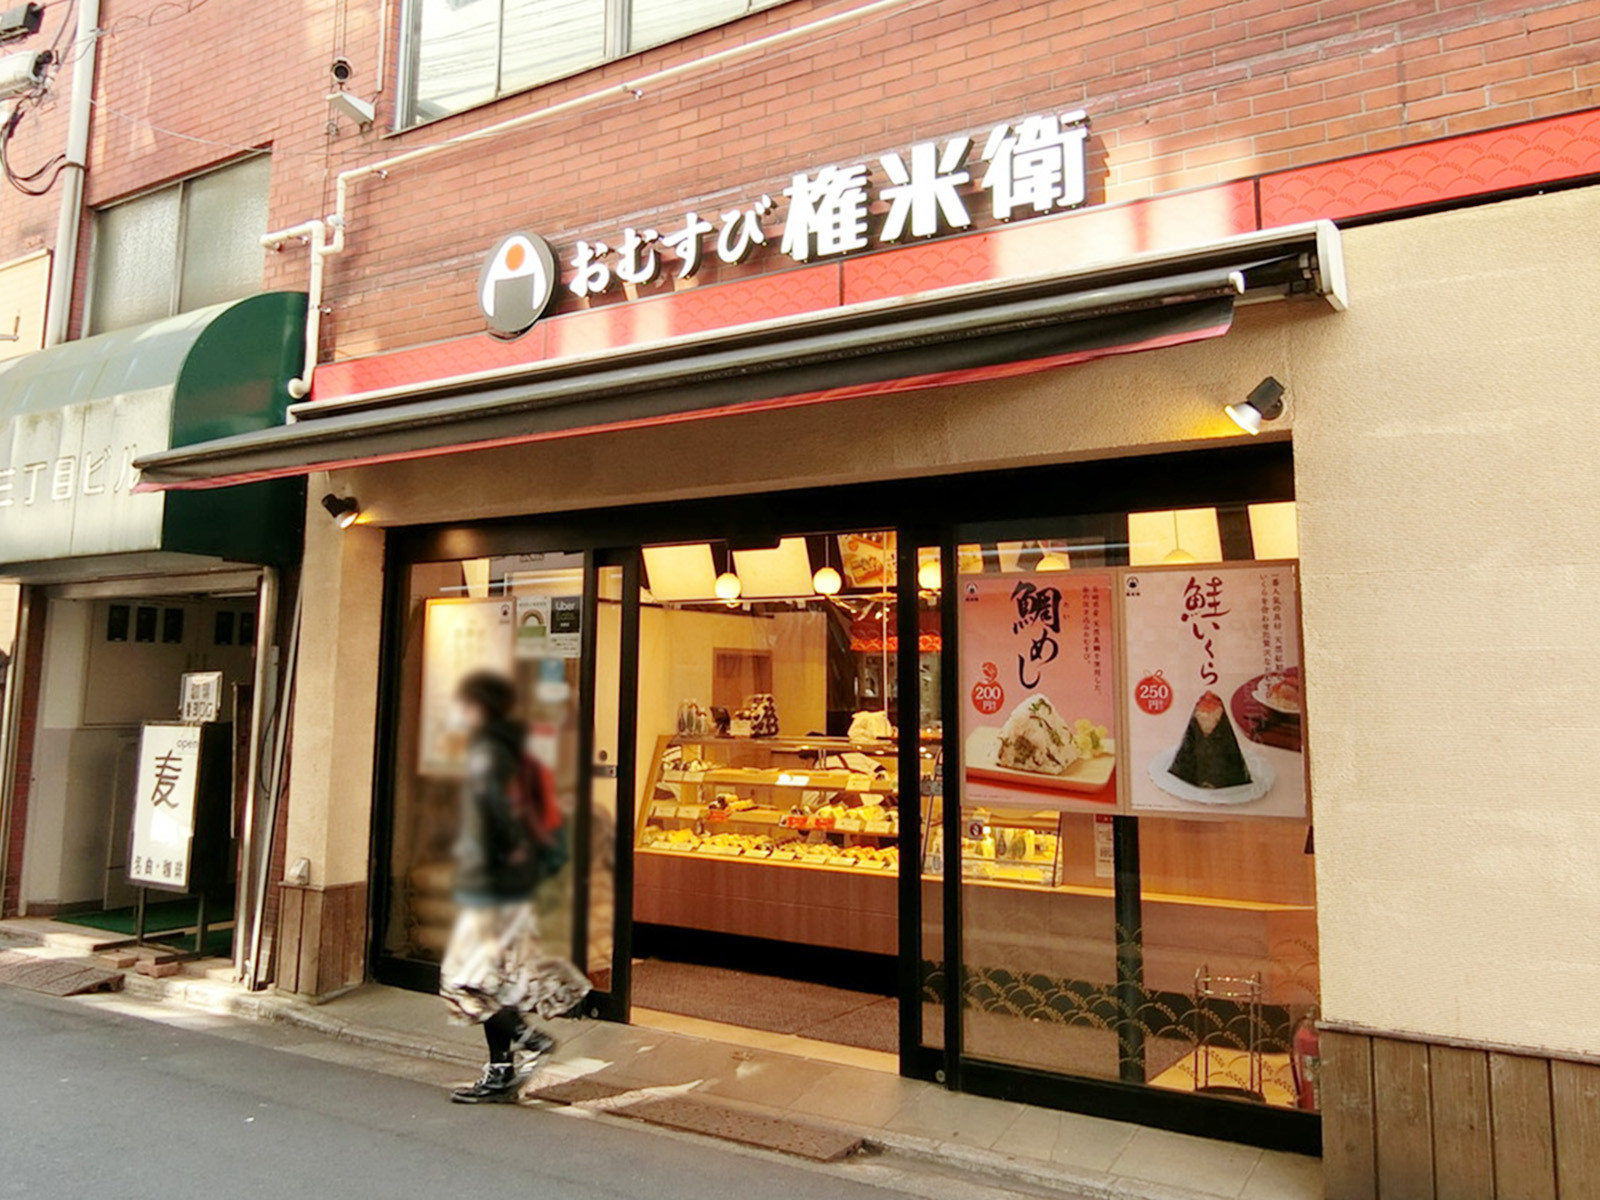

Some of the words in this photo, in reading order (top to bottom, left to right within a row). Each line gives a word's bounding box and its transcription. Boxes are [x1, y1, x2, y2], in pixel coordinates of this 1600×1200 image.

[555, 601, 576, 611] Uber
[1010, 580, 1062, 689] 鯛めし
[1181, 576, 1231, 686] 鮭いくら
[975, 686, 1002, 700] 200
[1140, 684, 1169, 699] 250
